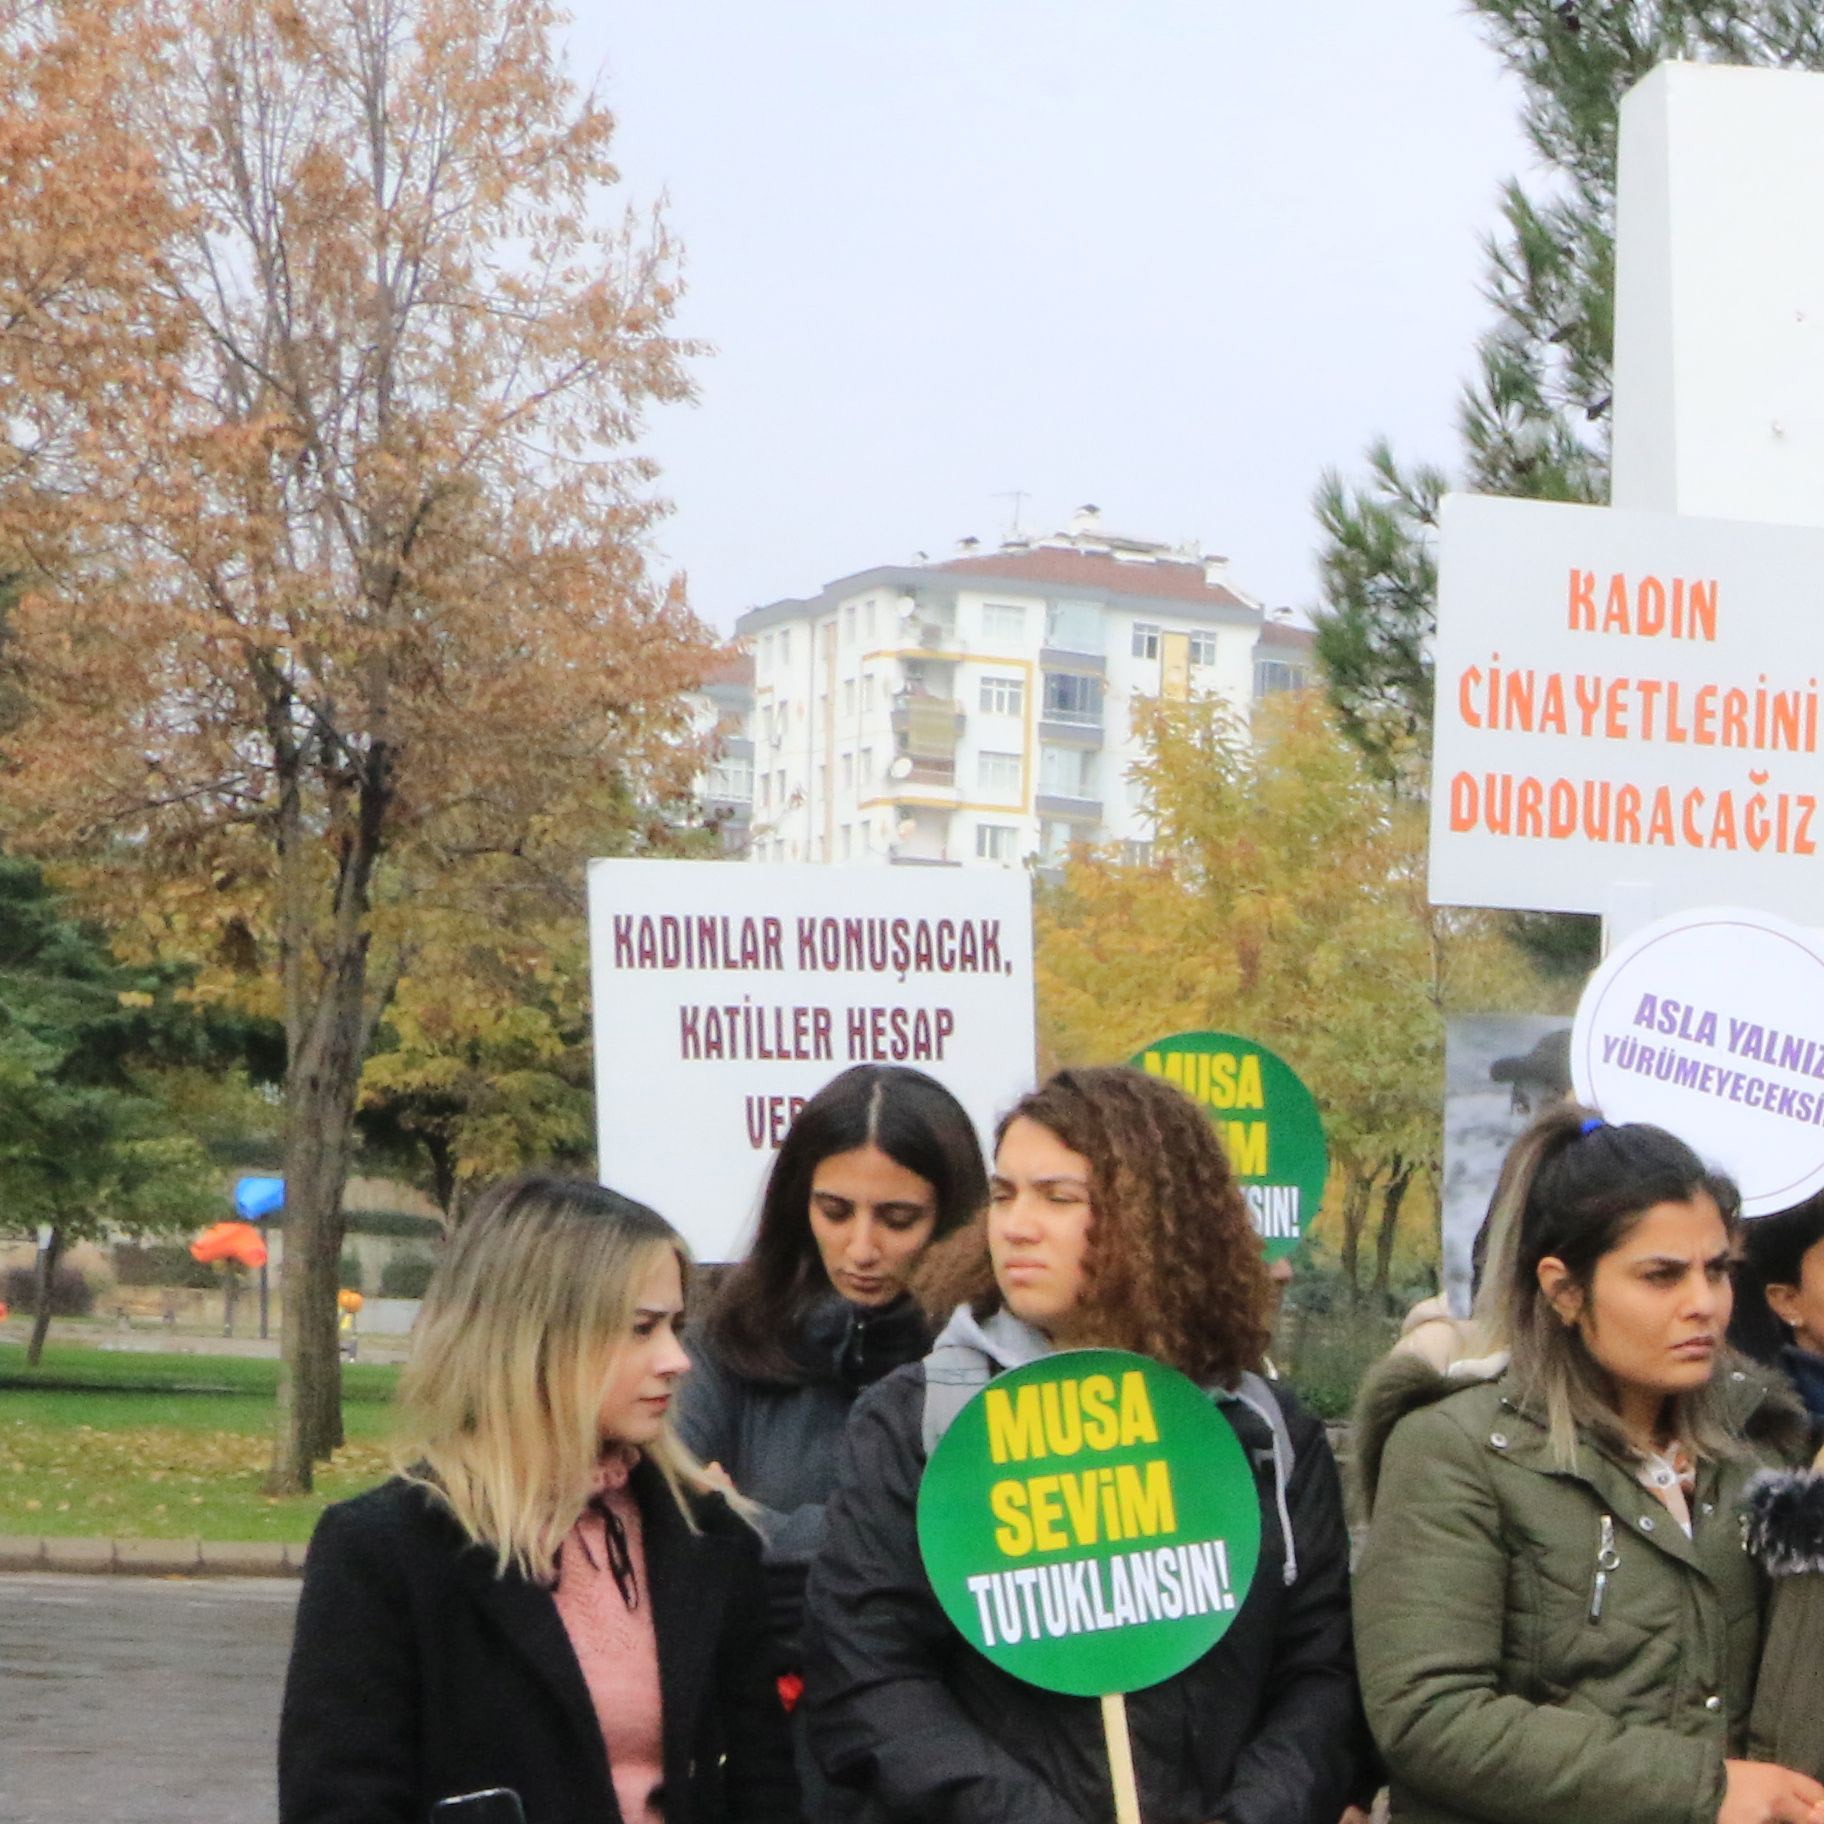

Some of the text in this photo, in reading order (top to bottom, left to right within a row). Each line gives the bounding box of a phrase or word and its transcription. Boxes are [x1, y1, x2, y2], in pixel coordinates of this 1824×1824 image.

[1568, 568, 1718, 641] KADIN
[1458, 651, 1819, 753] CİNAYETLERİNİ
[1449, 768, 1817, 855] DURDURACAĞIZ
[613, 914, 1013, 982] KADINLAR KONUŞACAK,
[680, 994, 955, 1062] KATİLLER HESAP
[1633, 992, 1717, 1047] ASLA
[985, 1371, 1159, 1464] MUSA
[967, 1539, 1236, 1647] TUTUKLANSIN!
